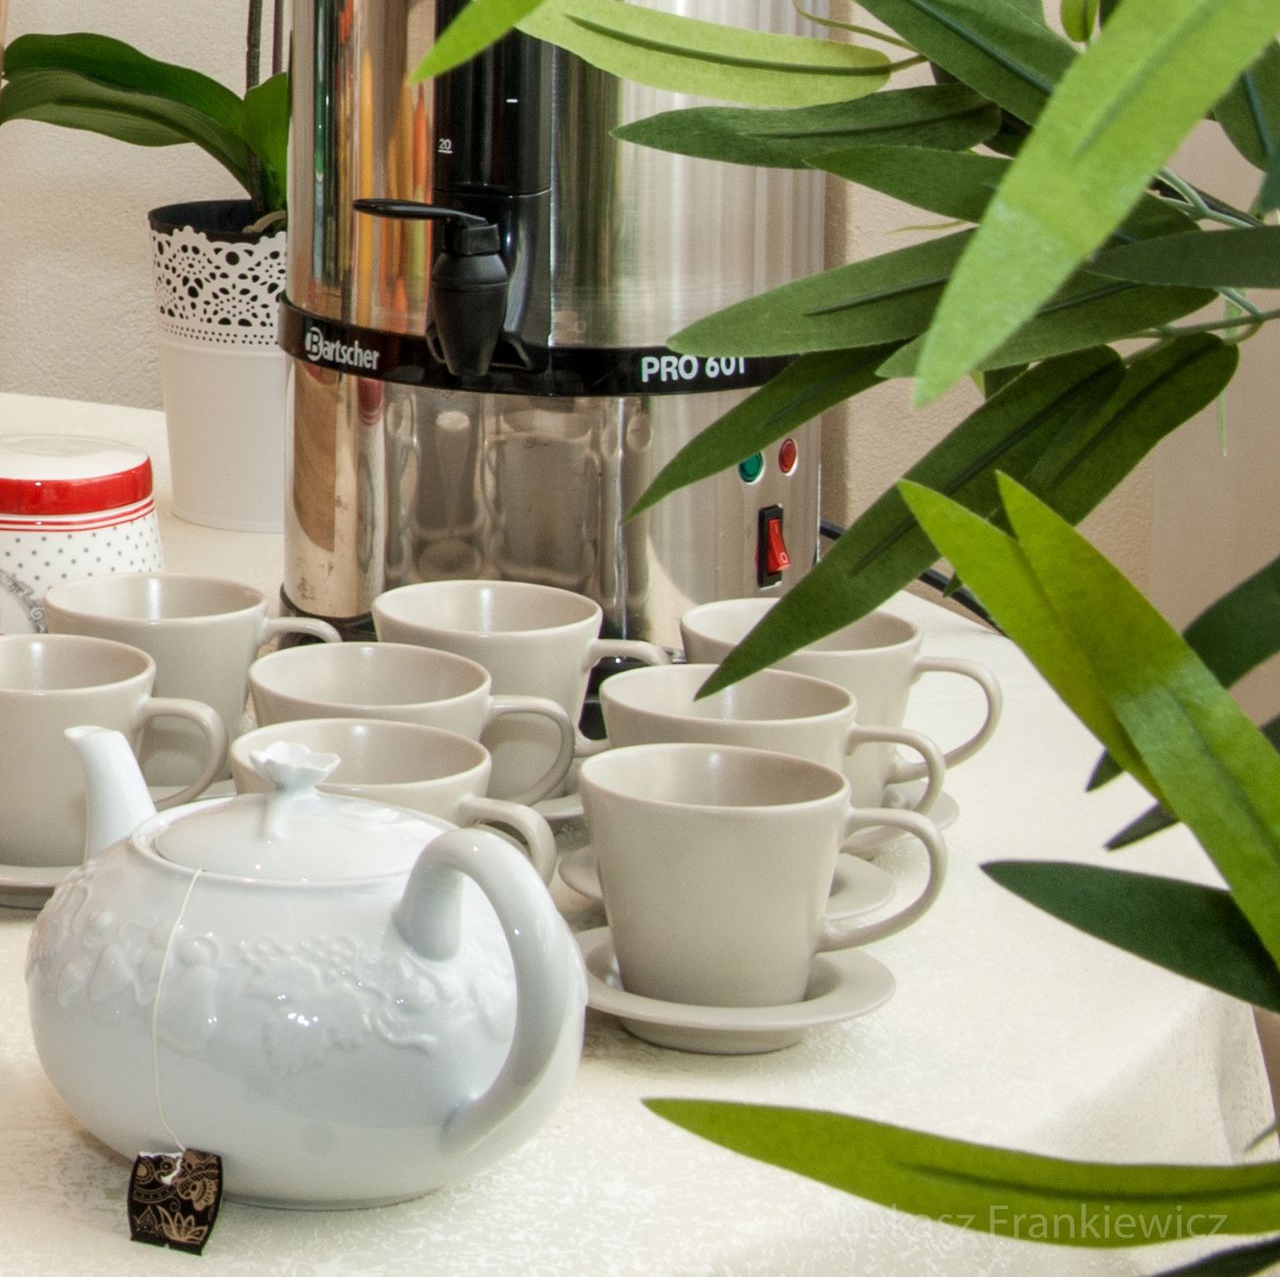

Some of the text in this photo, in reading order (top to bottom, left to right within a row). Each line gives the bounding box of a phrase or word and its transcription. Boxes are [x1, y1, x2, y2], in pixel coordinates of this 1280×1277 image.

[439, 138, 452, 150] 20
[305, 326, 380, 370] Bartscher
[641, 354, 699, 383] PRO
